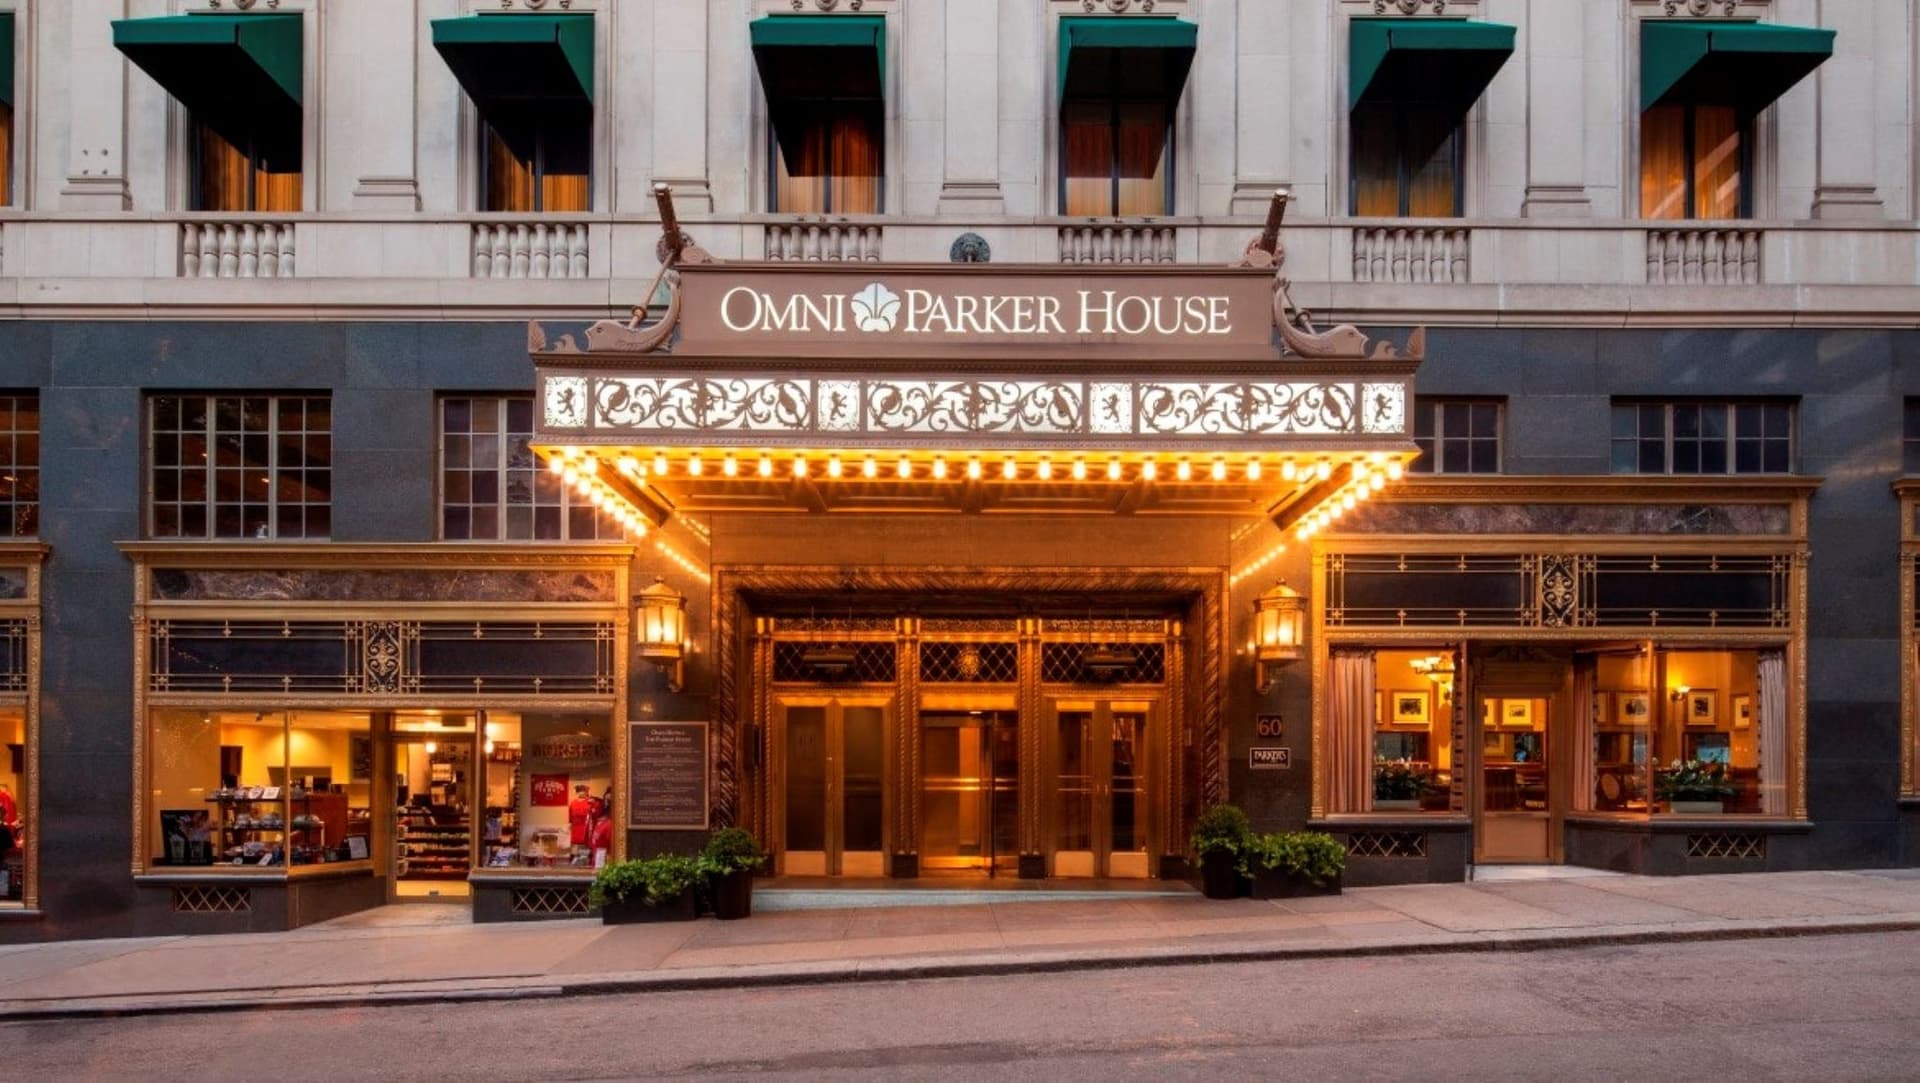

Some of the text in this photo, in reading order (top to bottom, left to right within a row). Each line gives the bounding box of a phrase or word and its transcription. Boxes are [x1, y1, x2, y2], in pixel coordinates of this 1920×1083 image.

[720, 286, 1233, 335] OMNI PARKER HOUSE
[1259, 719, 1282, 736] 60
